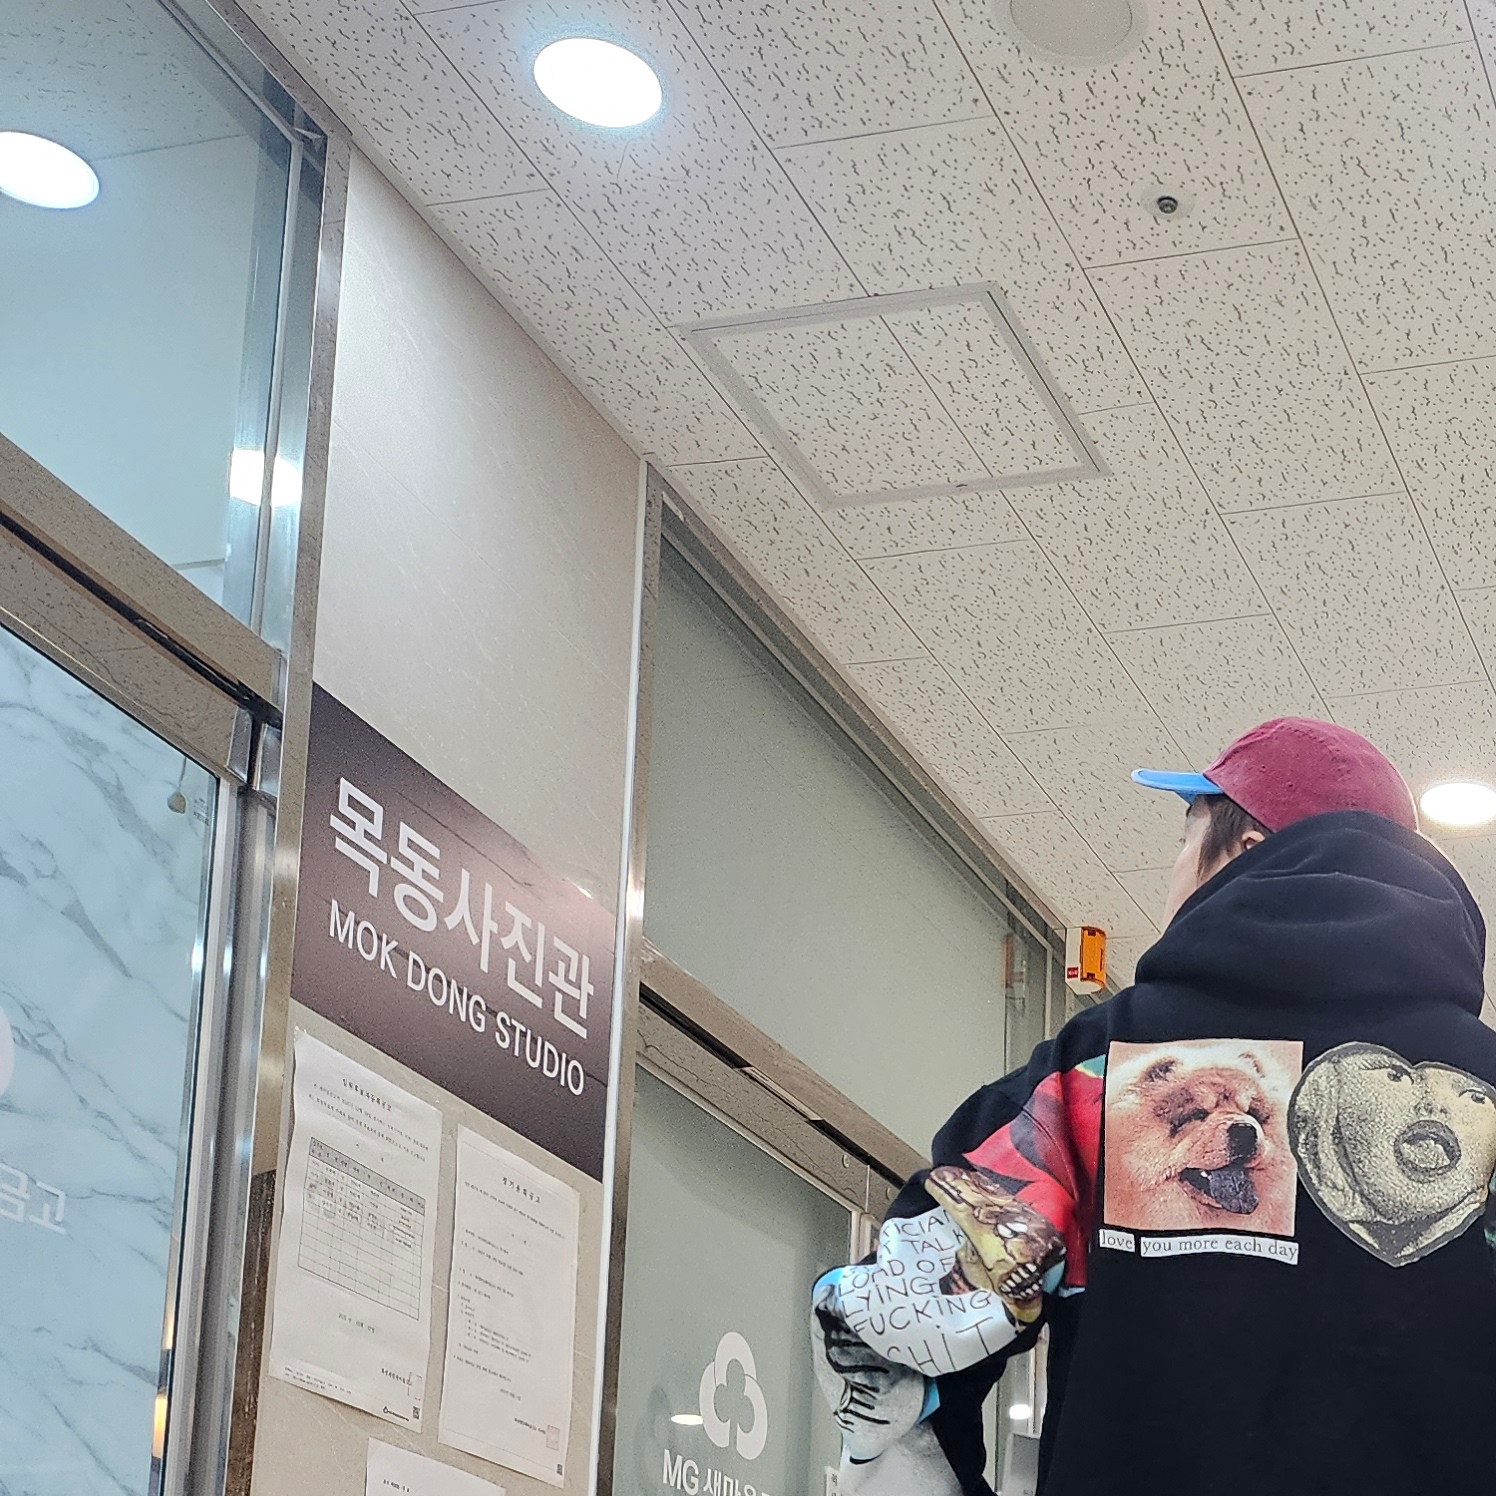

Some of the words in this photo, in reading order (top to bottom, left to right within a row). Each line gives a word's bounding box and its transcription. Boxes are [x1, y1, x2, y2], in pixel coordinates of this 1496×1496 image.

[329, 777, 594, 1039] 목동사진관
[329, 899, 398, 980] MOK
[407, 950, 487, 1033] DONG
[495, 1011, 585, 1096] STUDIO
[901, 1229, 965, 1255] TALK
[1101, 1230, 1133, 1249] love
[1142, 1240, 1173, 1255] you
[1178, 1238, 1218, 1250] more
[1225, 1237, 1262, 1253] each
[1268, 1240, 1298, 1260] day
[916, 1257, 955, 1273] OF
[853, 1290, 992, 1335] FUCKING
[663, 1449, 699, 1496] MG
